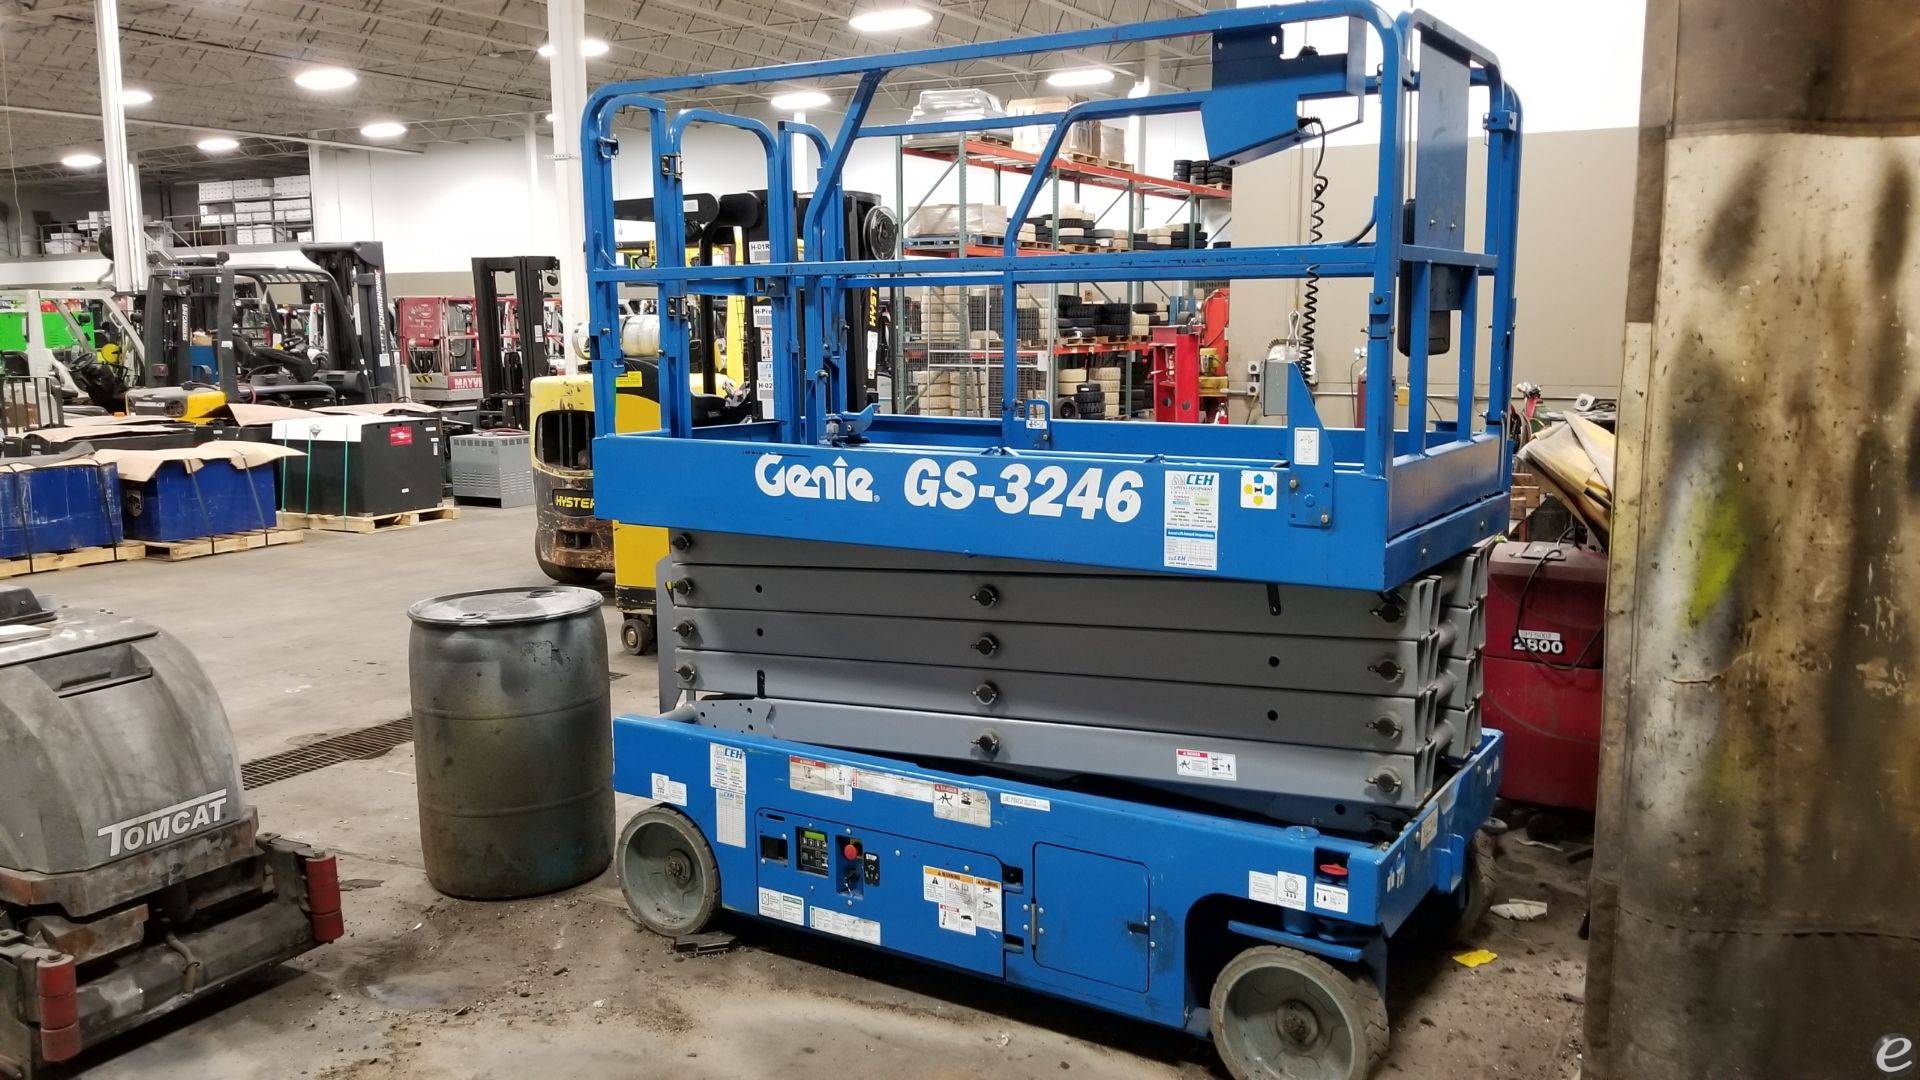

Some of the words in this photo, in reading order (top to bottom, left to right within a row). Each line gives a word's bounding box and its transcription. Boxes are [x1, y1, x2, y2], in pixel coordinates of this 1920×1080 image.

[754, 454, 874, 502] Genie
[903, 457, 1144, 523] GS-3246
[1186, 473, 1214, 486] CEH
[1513, 637, 1563, 654] 2800
[724, 747, 743, 760] CEH
[97, 788, 227, 857] TOMCAT
